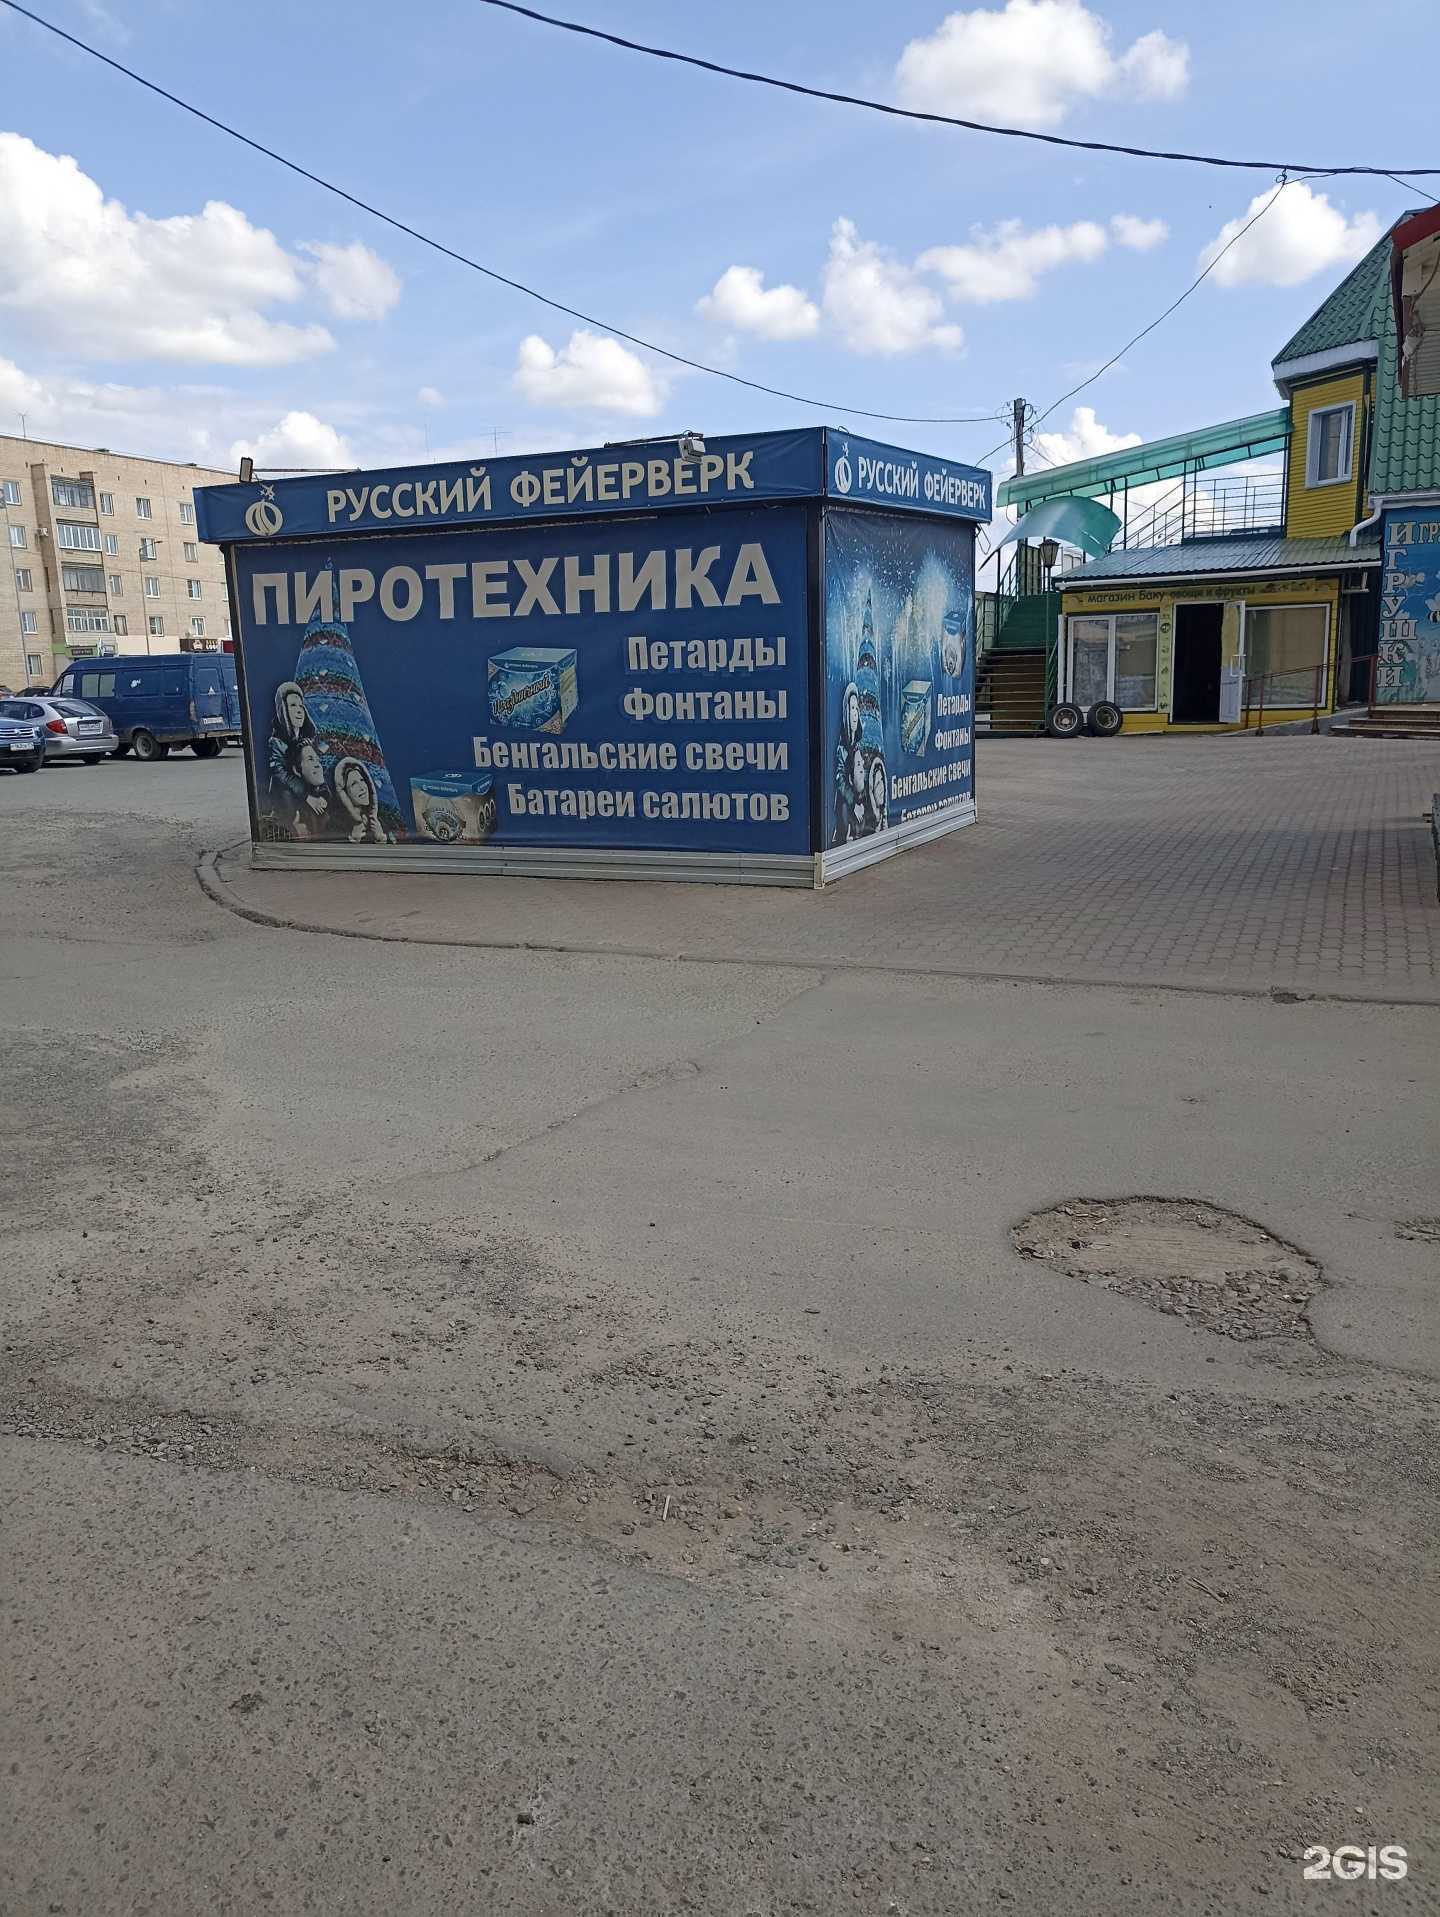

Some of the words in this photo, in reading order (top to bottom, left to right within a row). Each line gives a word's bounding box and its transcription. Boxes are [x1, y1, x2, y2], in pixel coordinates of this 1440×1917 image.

[326, 466, 492, 523] РУССКИЙ
[510, 450, 755, 508] ФЕЙЕРВЕРК
[858, 456, 919, 499] РУССКИЙ
[924, 467, 986, 511] ФЕЙЕРВЕРК
[252, 542, 782, 625] ПИРОТЕХНИКА
[1088, 592, 1135, 603] магазин
[1139, 589, 1165, 602] Баку
[1376, 521, 1418, 688] ИГРУШКИ
[628, 635, 787, 672] Петарды
[623, 687, 787, 721] Фонтаны
[937, 693, 971, 717] Петарды
[473, 736, 678, 773] Бенгальские
[685, 741, 788, 770] свечи
[935, 726, 971, 752] Фонтаны
[891, 763, 947, 800] Бенгальские
[948, 759, 971, 782] свечи
[508, 783, 635, 820] Батареи
[642, 790, 789, 822] салютов
